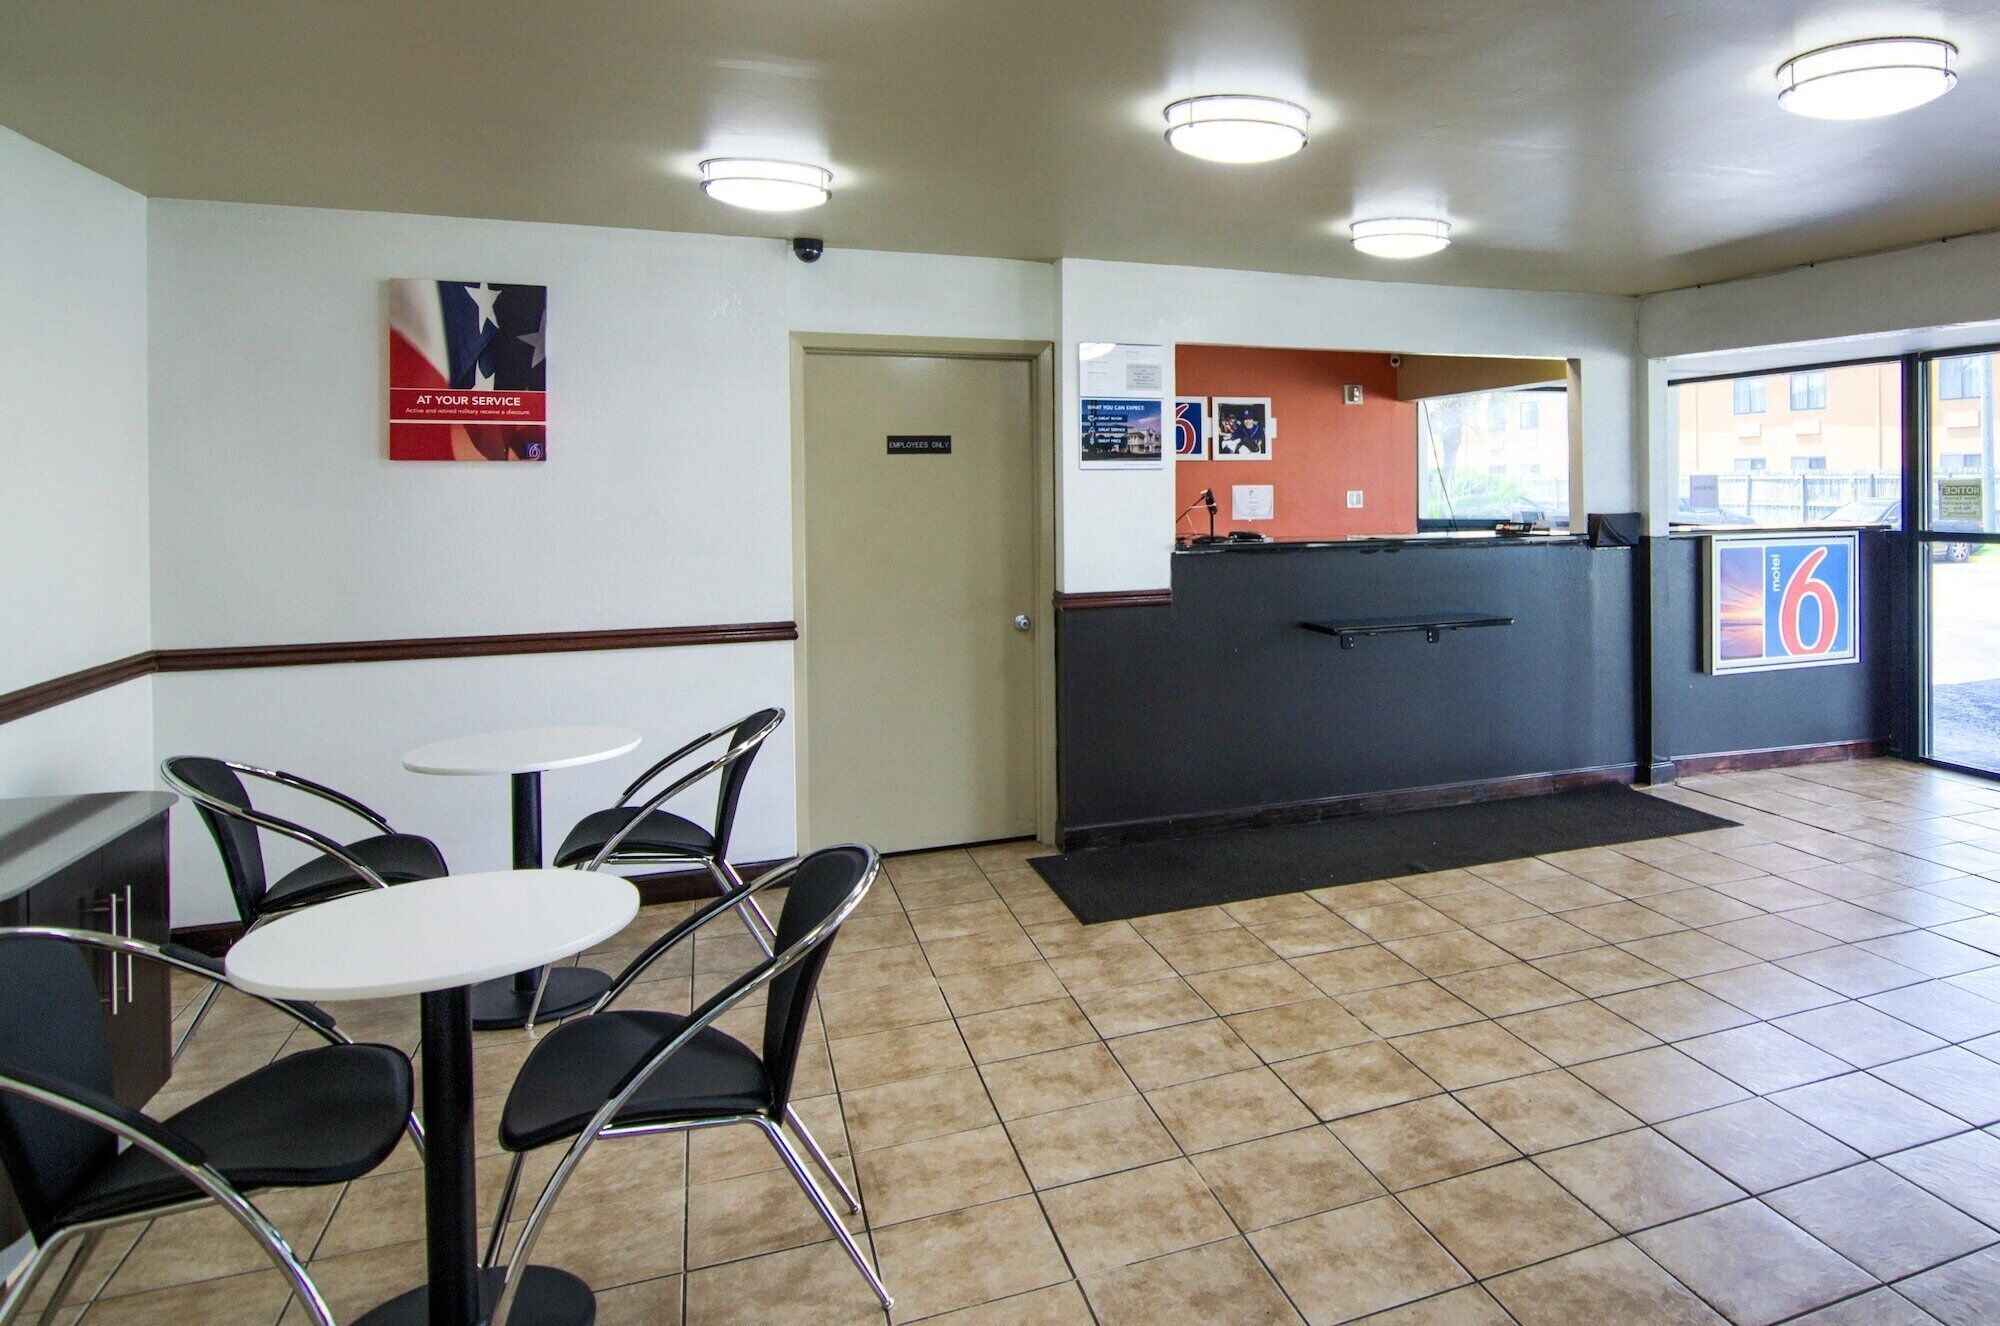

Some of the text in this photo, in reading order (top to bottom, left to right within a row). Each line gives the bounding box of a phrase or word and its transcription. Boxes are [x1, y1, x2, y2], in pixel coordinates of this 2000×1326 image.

[416, 395, 521, 407] AT YOUR SERVICE
[457, 408, 479, 416] military
[888, 441, 950, 449] EMPLOYEES ONLY
[1771, 546, 1839, 656] motel 6
